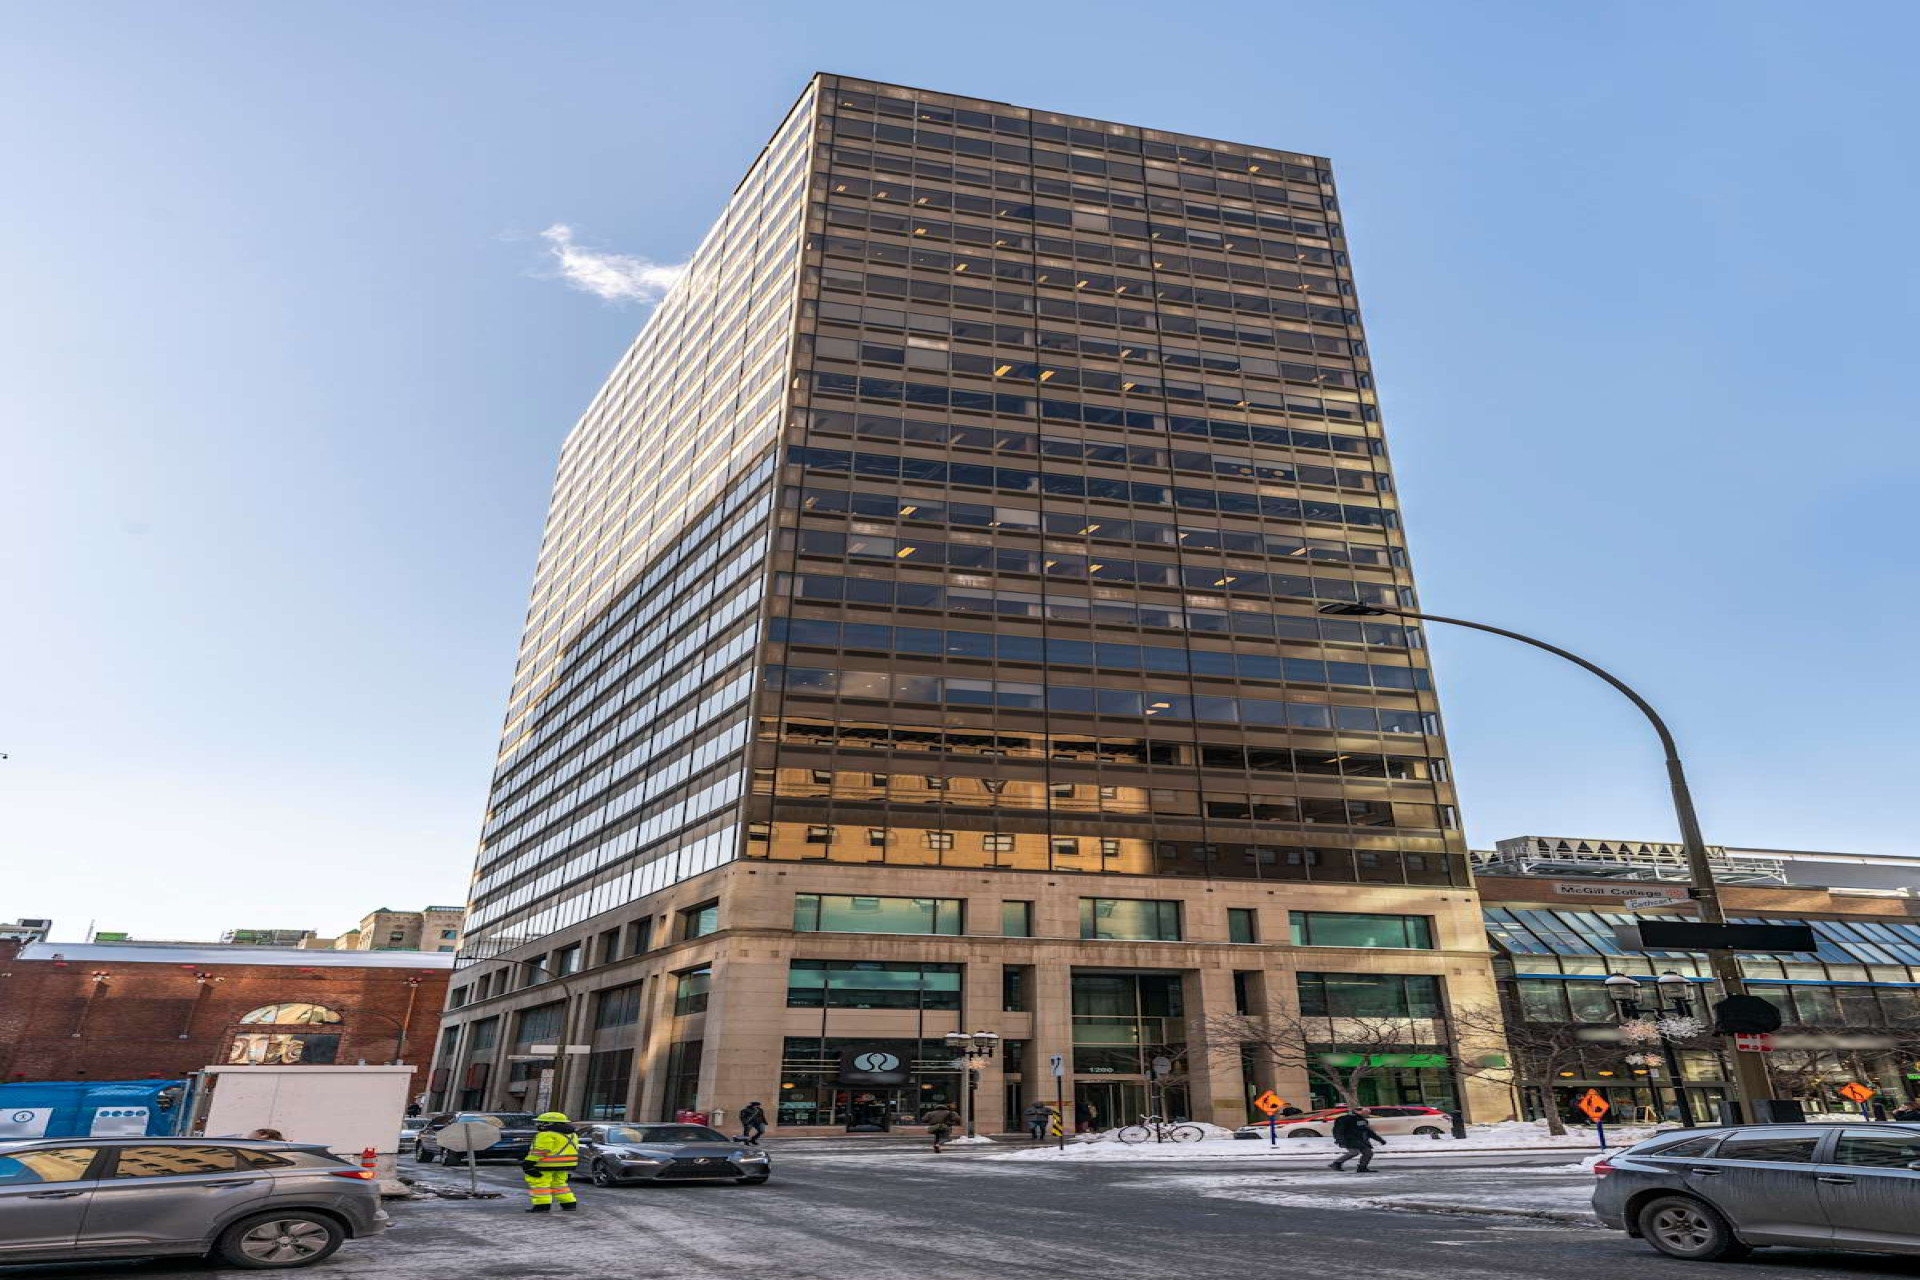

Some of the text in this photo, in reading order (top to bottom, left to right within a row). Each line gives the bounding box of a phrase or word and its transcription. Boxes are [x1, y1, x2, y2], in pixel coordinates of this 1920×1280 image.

[1561, 887, 1662, 898] McGill College
[1631, 898, 1673, 908] Cathcart
